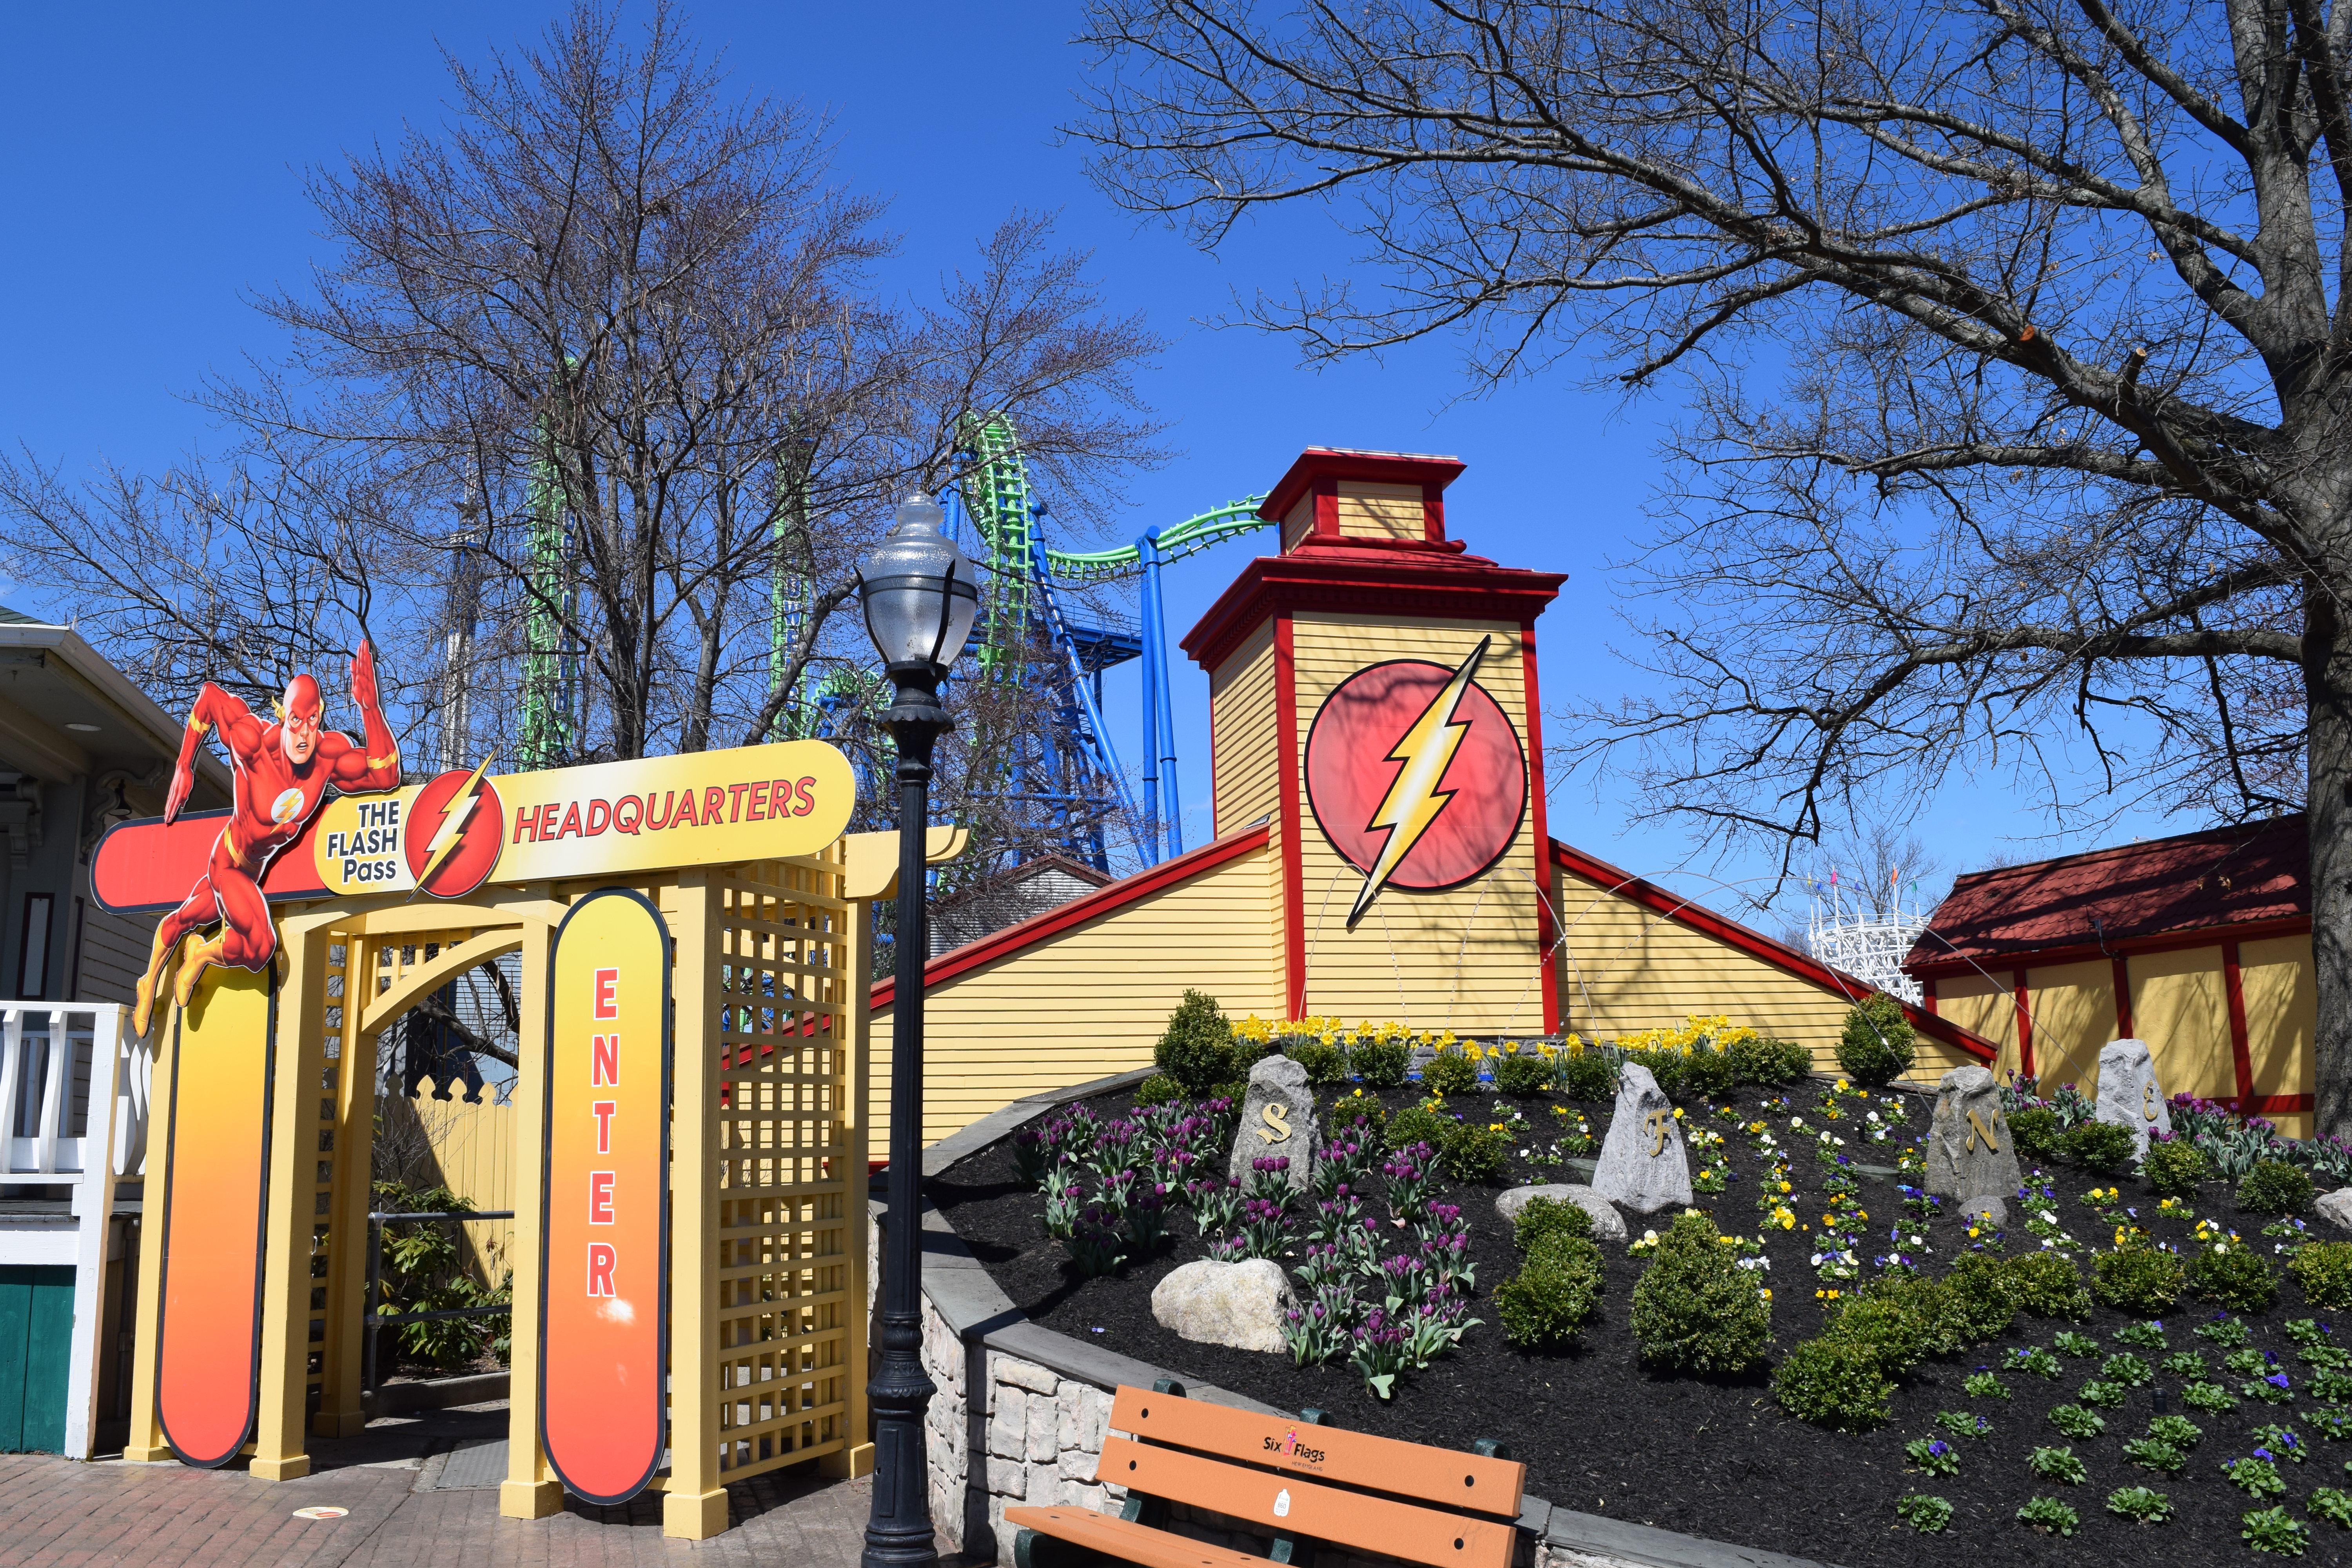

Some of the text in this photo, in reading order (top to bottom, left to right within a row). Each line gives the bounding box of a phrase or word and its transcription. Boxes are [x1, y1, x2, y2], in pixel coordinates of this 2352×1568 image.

[358, 800, 400, 829] THE
[513, 776, 817, 844] HEADQUARTERS
[327, 827, 397, 858] FLASH
[343, 858, 397, 883] Pass
[587, 967, 619, 1297] ENTER
[1256, 1103, 1291, 1144] S
[1966, 1109, 1999, 1151] N
[1263, 1436, 1325, 1463] Six Flags
[1302, 1463, 1323, 1472] ENGLAND
